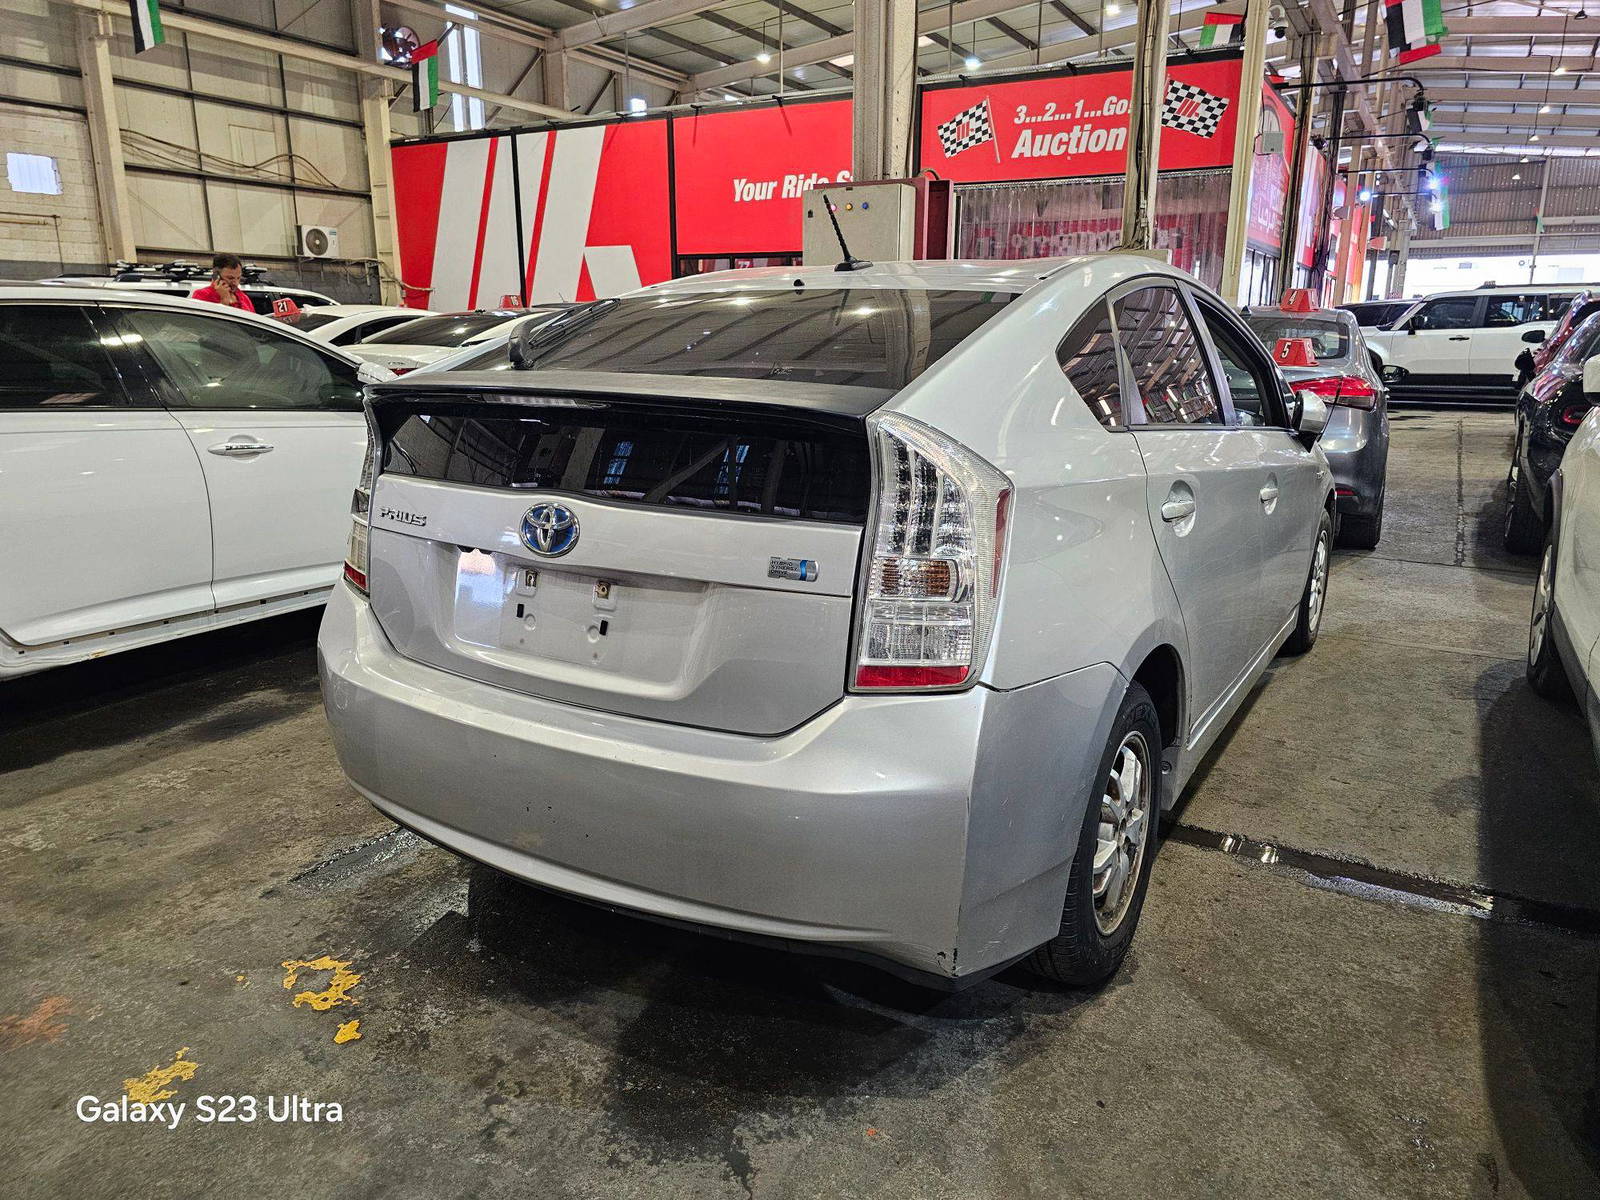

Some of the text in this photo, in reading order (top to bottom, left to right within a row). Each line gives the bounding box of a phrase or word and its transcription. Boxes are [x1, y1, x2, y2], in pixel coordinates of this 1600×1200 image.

[1010, 123, 1128, 159] Auction
[732, 178, 778, 202] Your
[277, 301, 288, 312] 21
[1281, 341, 1292, 358] 5
[379, 507, 428, 527] PRIUS
